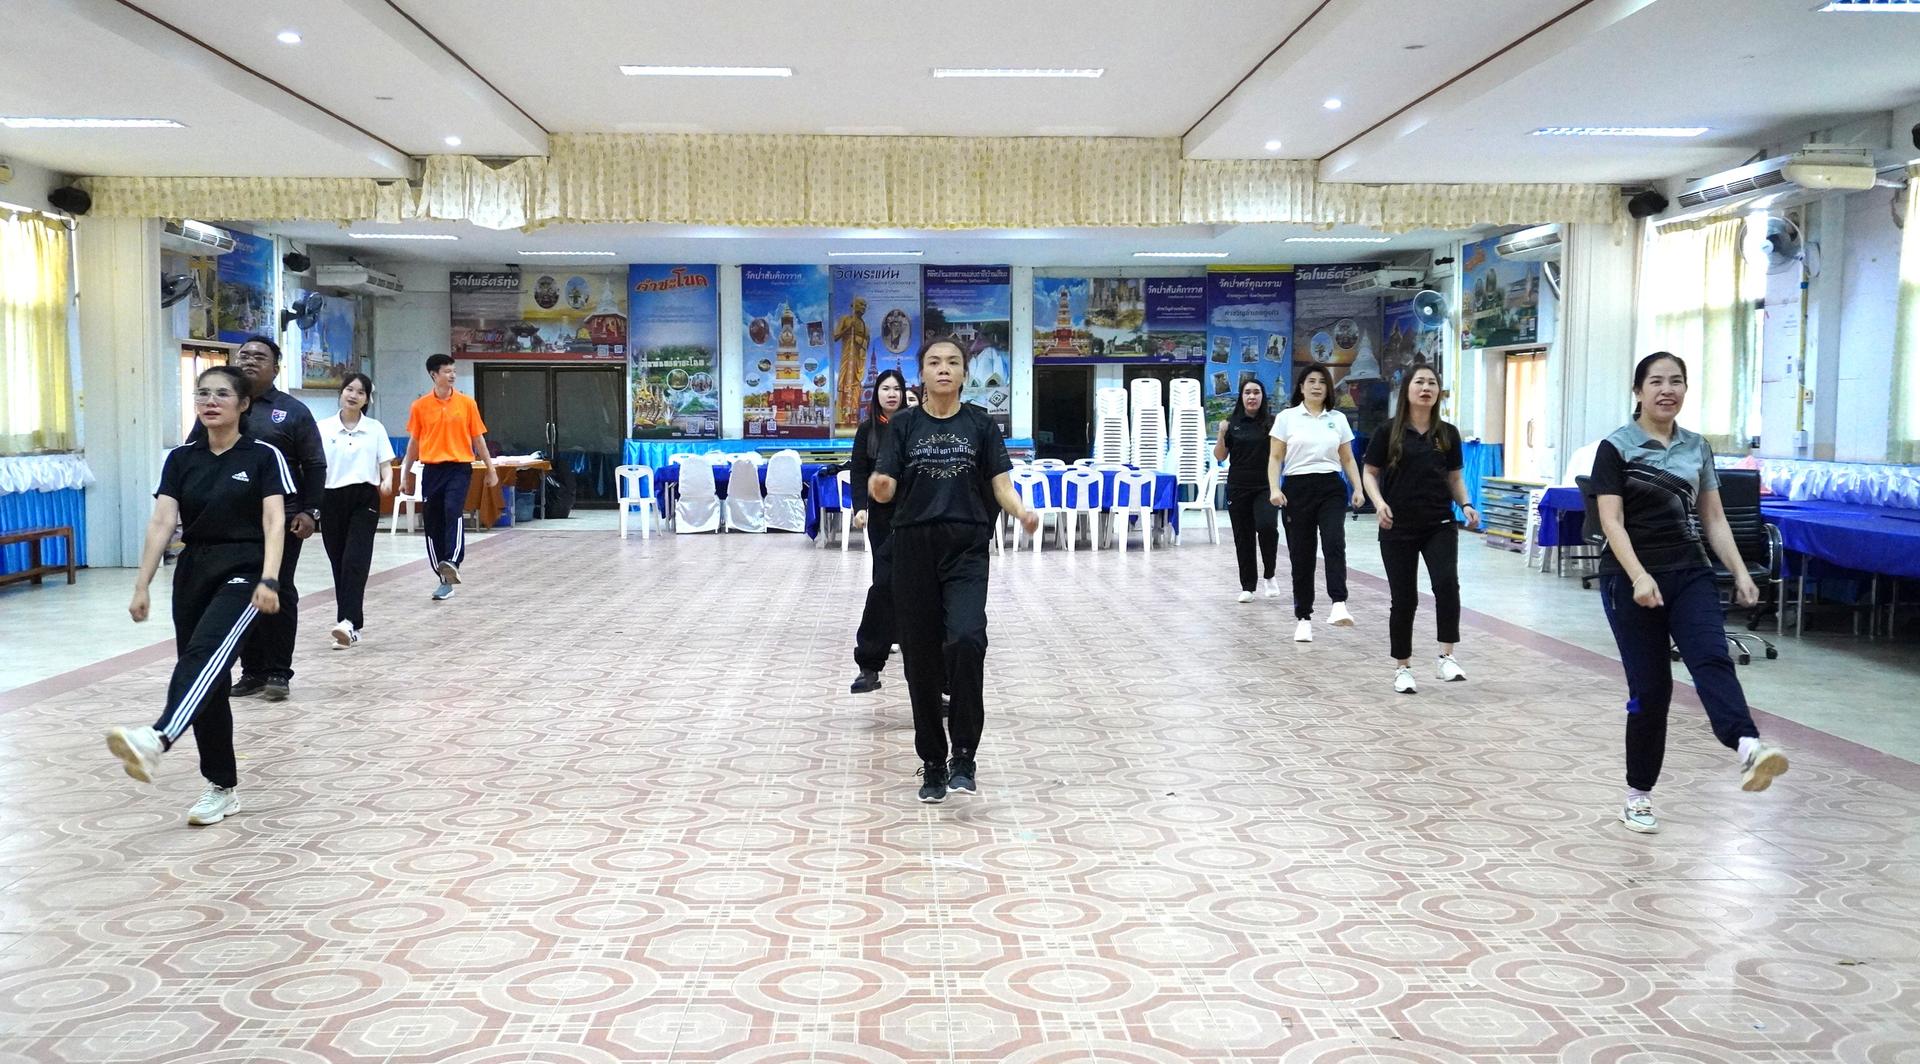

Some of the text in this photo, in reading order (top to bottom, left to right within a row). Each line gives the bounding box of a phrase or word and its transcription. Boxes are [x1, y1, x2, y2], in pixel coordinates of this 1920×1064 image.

[452, 273, 519, 289] วัดโพธิ์ศรีทุ่ง
[635, 267, 708, 292] คำชะโนด
[837, 266, 900, 280] วัดพระแท่น
